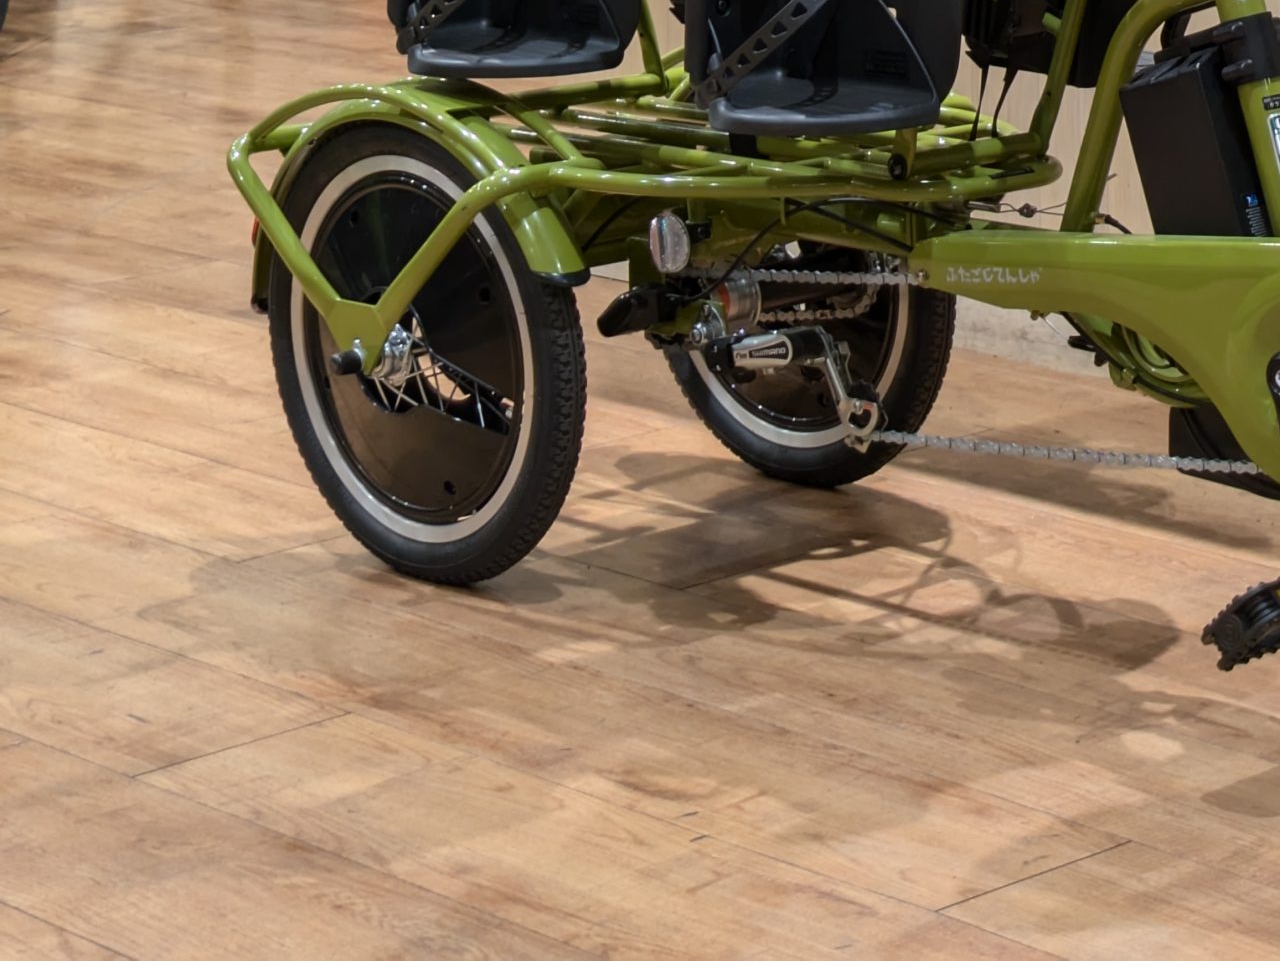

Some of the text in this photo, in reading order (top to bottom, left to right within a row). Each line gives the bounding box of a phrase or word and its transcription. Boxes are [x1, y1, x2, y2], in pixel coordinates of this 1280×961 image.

[946, 266, 1040, 284] ふたごじてんしゃ
